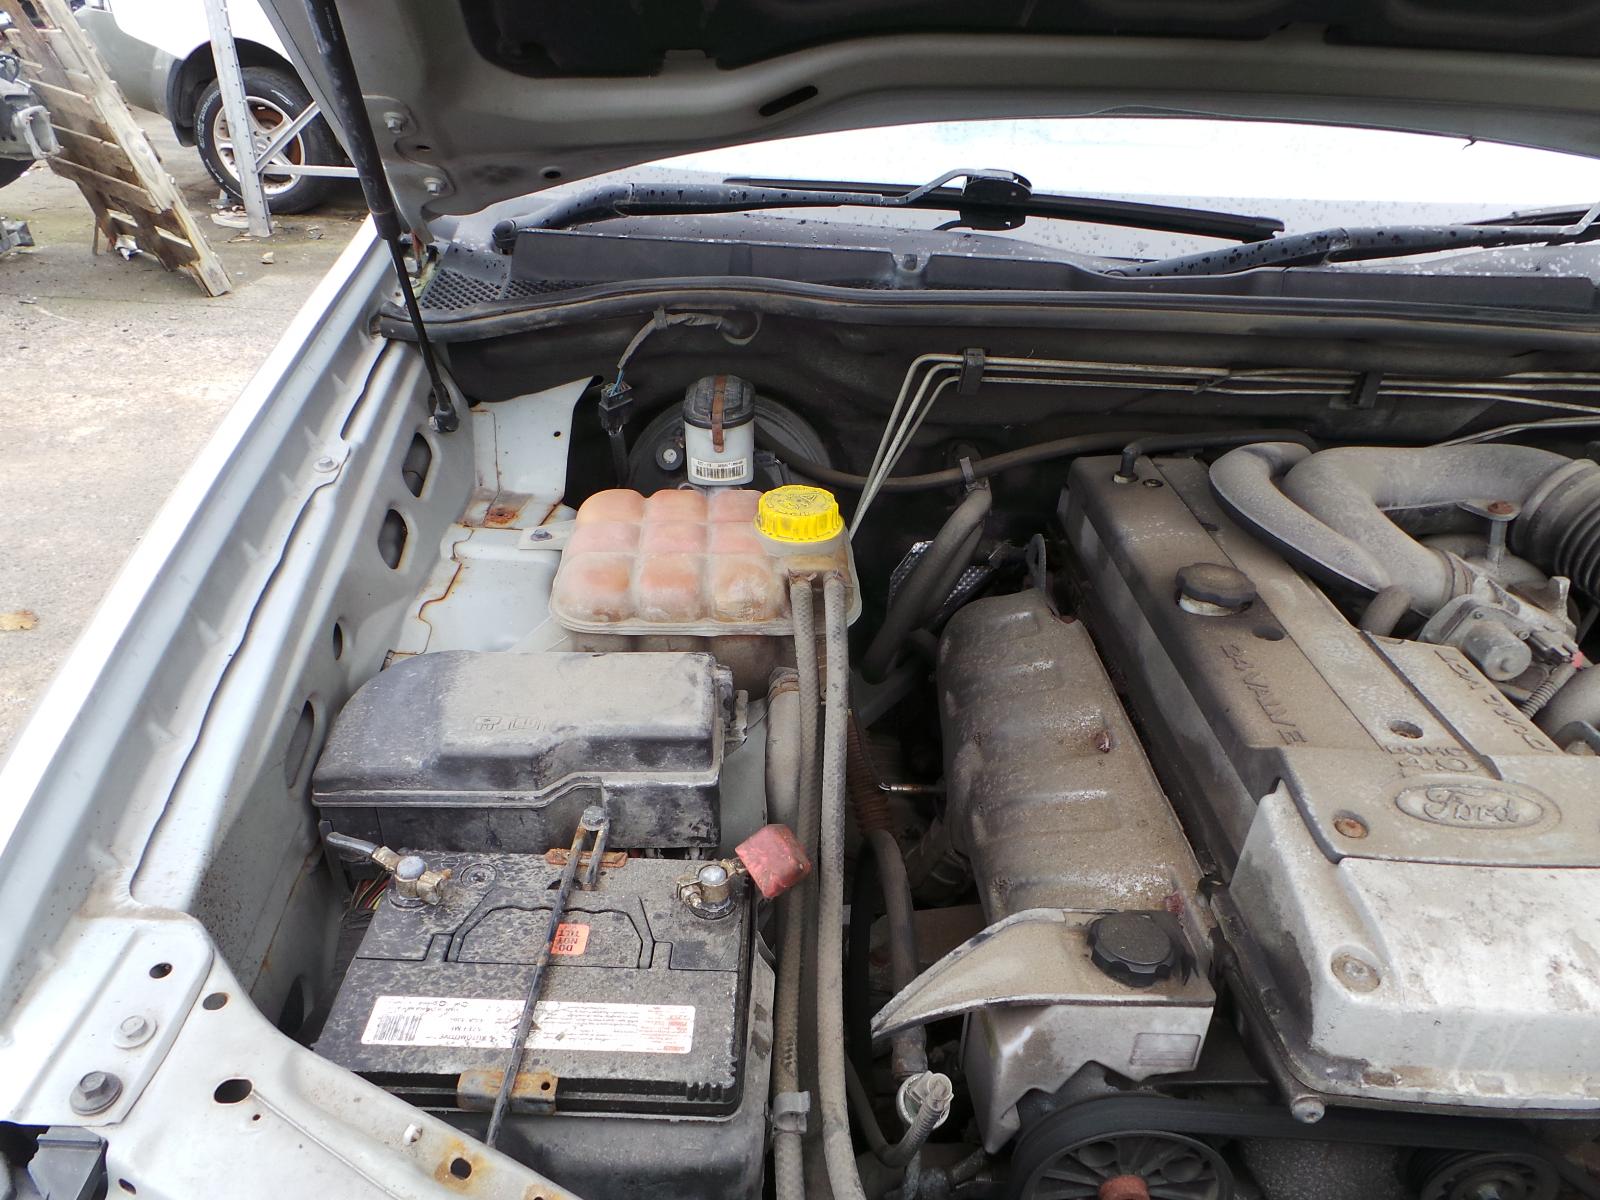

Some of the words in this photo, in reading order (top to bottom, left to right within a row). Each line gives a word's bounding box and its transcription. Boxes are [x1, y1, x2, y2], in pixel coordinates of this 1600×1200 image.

[1242, 673, 1308, 746] VALVE
[1384, 744, 1467, 758] DOHC
[1422, 788, 1520, 823] Ford
[557, 929, 580, 937] TILT
[558, 944, 574, 952] DO
